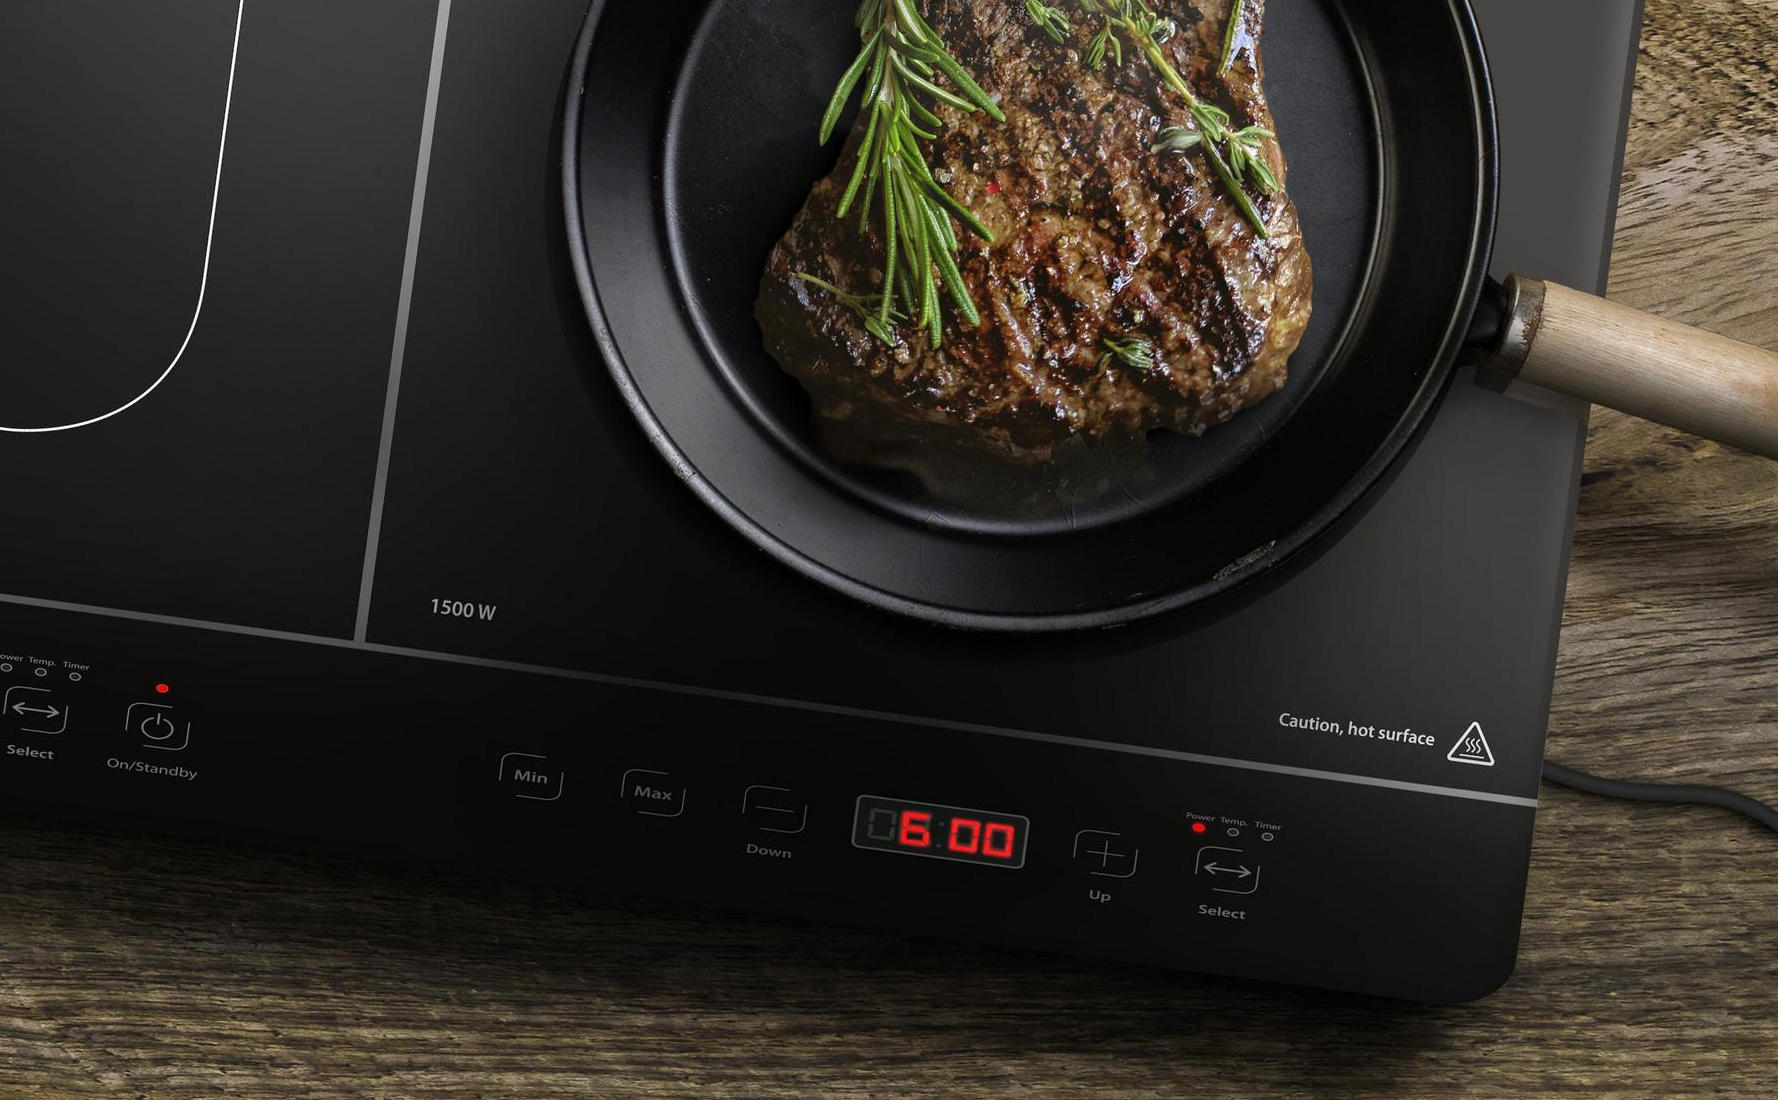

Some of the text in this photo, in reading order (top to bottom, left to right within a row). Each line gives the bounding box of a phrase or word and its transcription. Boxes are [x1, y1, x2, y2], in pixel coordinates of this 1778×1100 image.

[430, 598, 497, 621] 1500 W
[28, 656, 57, 667] Temp.
[63, 660, 90, 671] Timer
[1278, 712, 1435, 746] Caution, hot surface
[6, 744, 55, 760] Select
[106, 758, 198, 781] On/Standby
[514, 768, 549, 785] Min
[634, 784, 673, 801] Max
[1185, 812, 1216, 822] Power
[1254, 820, 1282, 831] Timer
[746, 843, 792, 859] Down
[1088, 889, 1111, 904] Up
[1198, 904, 1246, 920] Select
